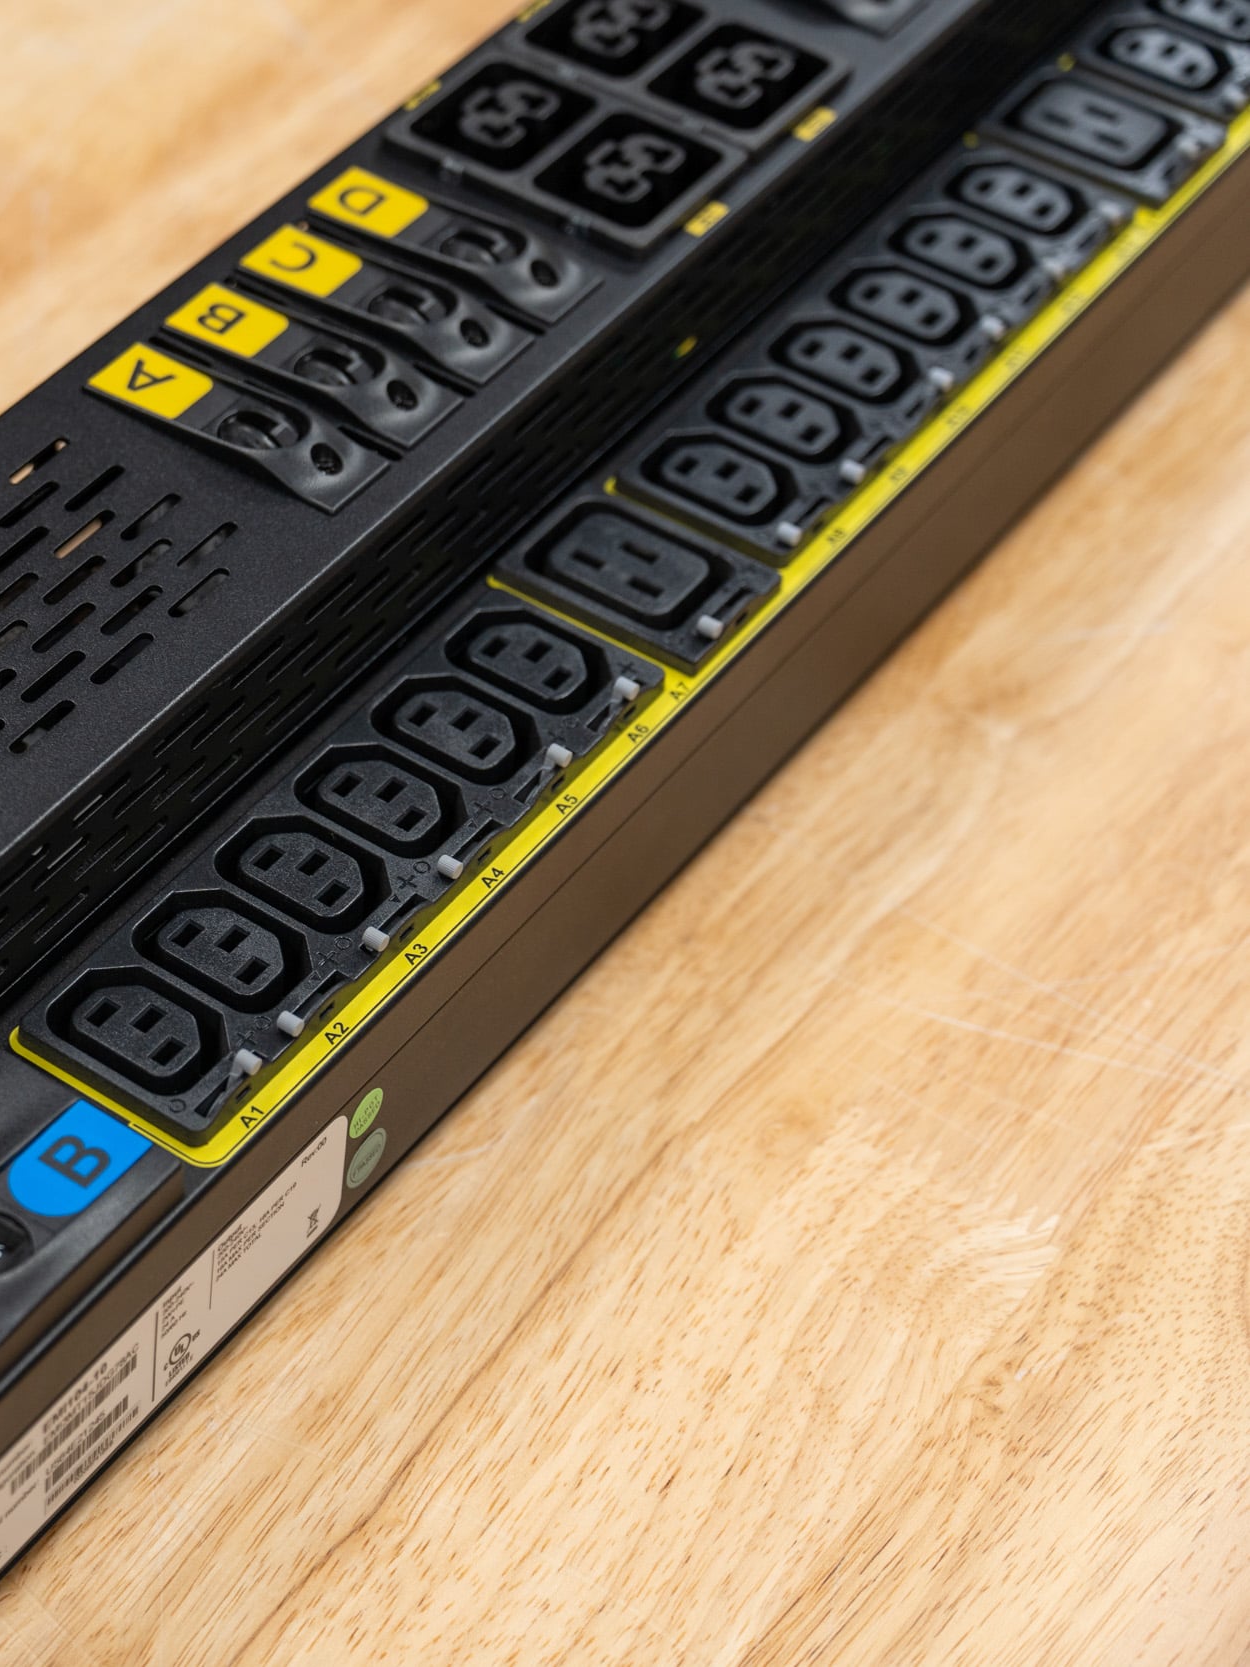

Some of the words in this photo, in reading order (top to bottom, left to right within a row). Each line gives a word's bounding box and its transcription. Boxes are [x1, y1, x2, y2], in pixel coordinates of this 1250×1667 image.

[339, 185, 385, 216] D
[270, 241, 317, 273] C
[197, 303, 245, 335] B
[126, 358, 177, 392] A
[670, 681, 689, 700] A7
[628, 724, 649, 743] A6
[555, 794, 578, 815] A5
[481, 867, 505, 889] A4
[404, 943, 428, 966] A3
[324, 1021, 350, 1046] A2
[240, 1105, 266, 1128] A1
[38, 1134, 111, 1187] B
